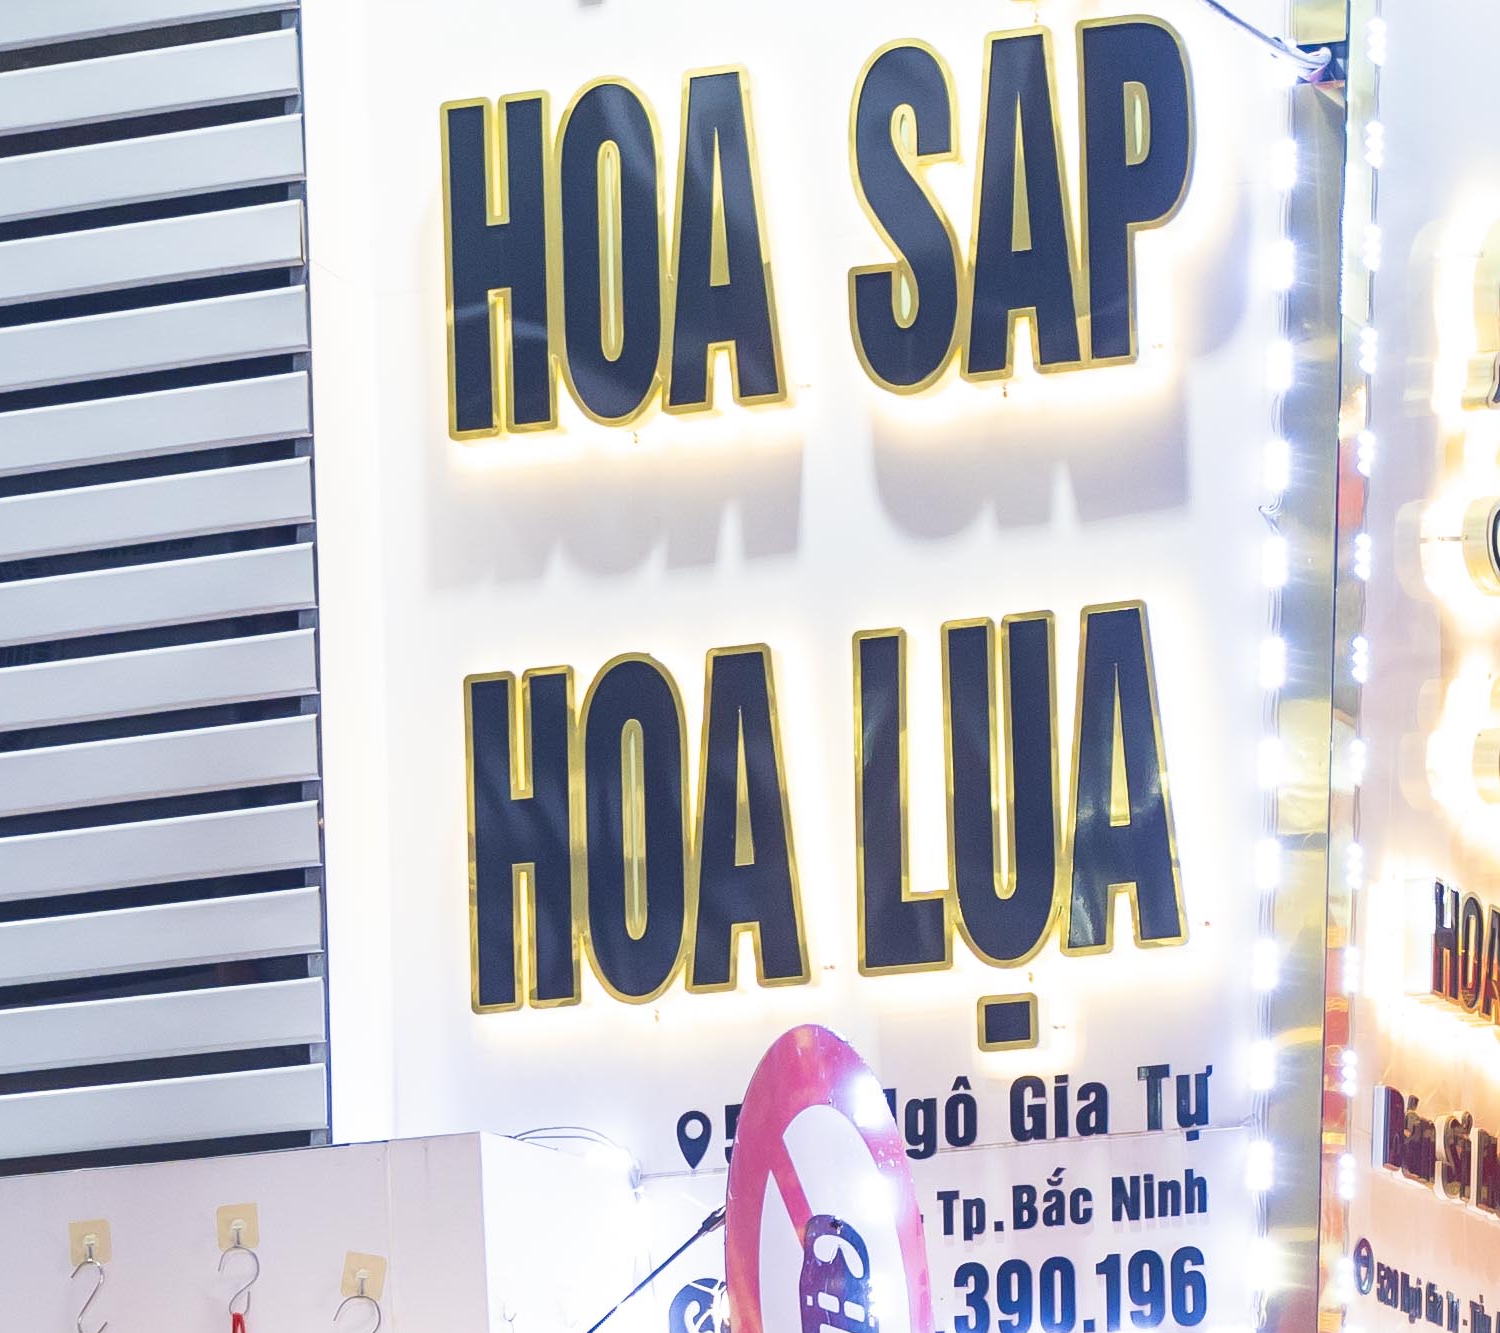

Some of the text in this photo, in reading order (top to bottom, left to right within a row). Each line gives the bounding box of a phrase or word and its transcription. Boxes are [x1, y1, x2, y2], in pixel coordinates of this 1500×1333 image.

[440, 64, 788, 442] HOA
[463, 600, 1189, 1054] HOA LỤA
[1008, 1074, 1110, 1143] Gia
[1137, 1063, 1214, 1142] Tự
[1110, 1169, 1209, 1224] Ninh
